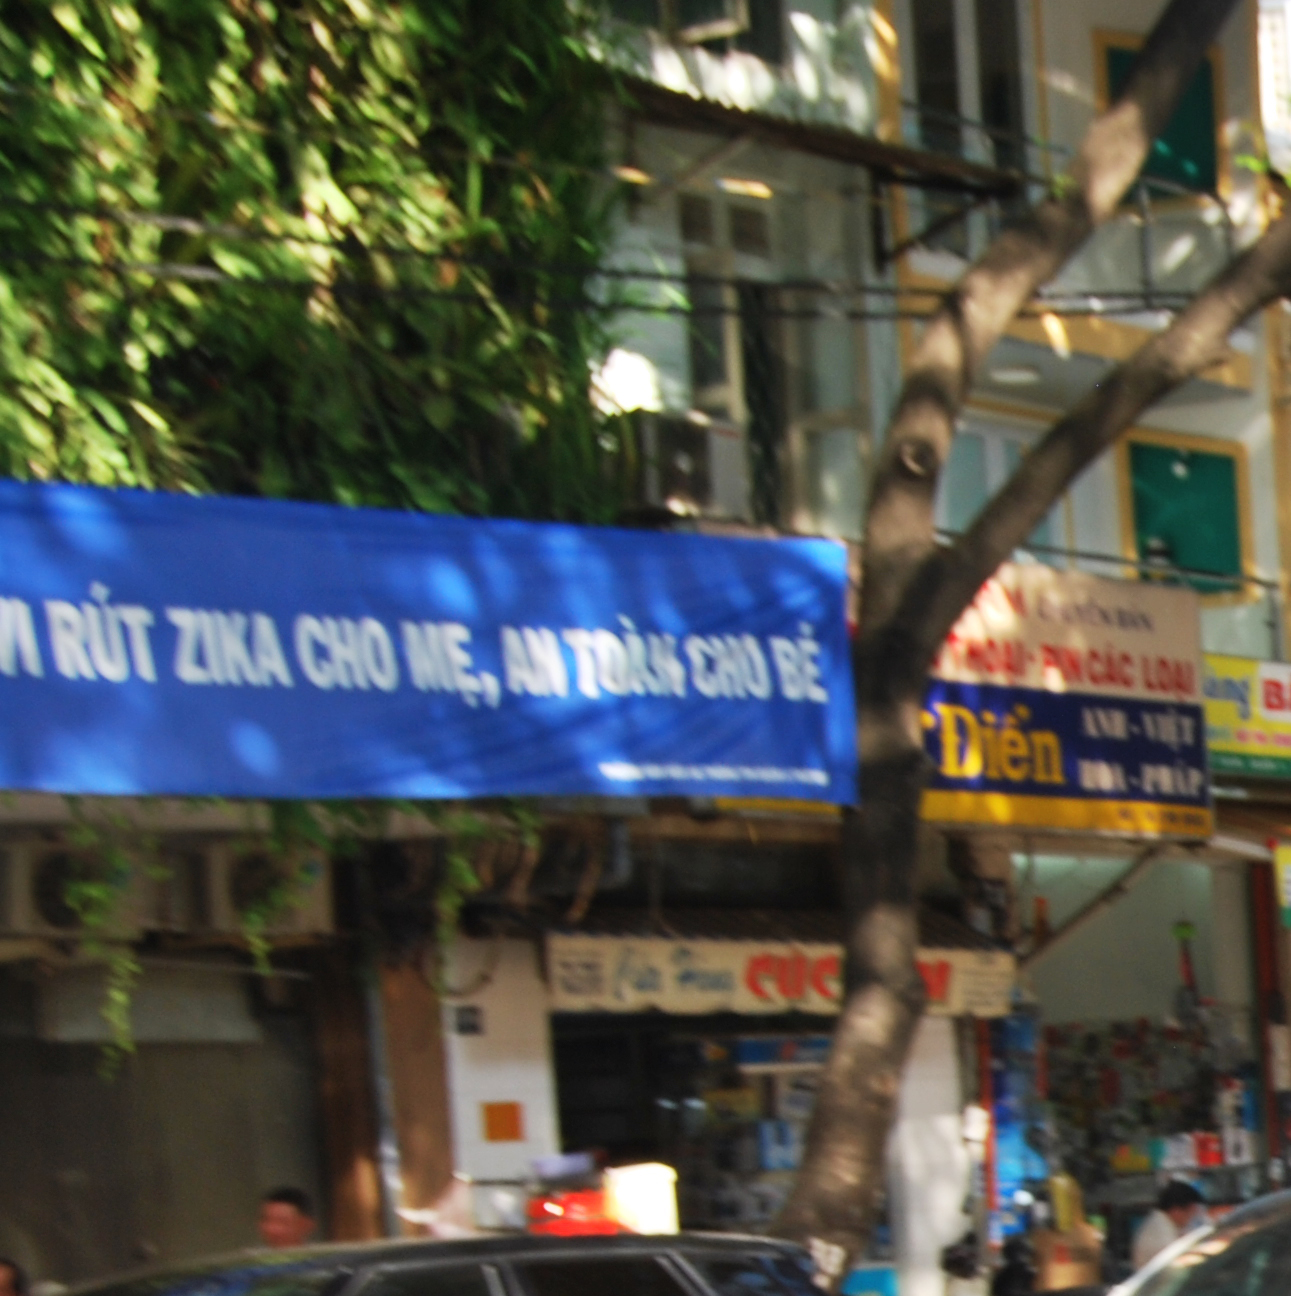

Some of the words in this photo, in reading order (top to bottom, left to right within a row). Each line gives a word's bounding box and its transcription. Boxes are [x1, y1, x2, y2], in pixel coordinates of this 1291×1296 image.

[44, 581, 158, 683] RÚT
[165, 606, 295, 688] ZIKA
[294, 613, 401, 693] CHO
[401, 621, 499, 709] MẸ,
[502, 625, 569, 698] AN
[562, 613, 686, 700] TOÀN
[685, 633, 772, 700] CHO
[770, 622, 829, 704] BÉ
